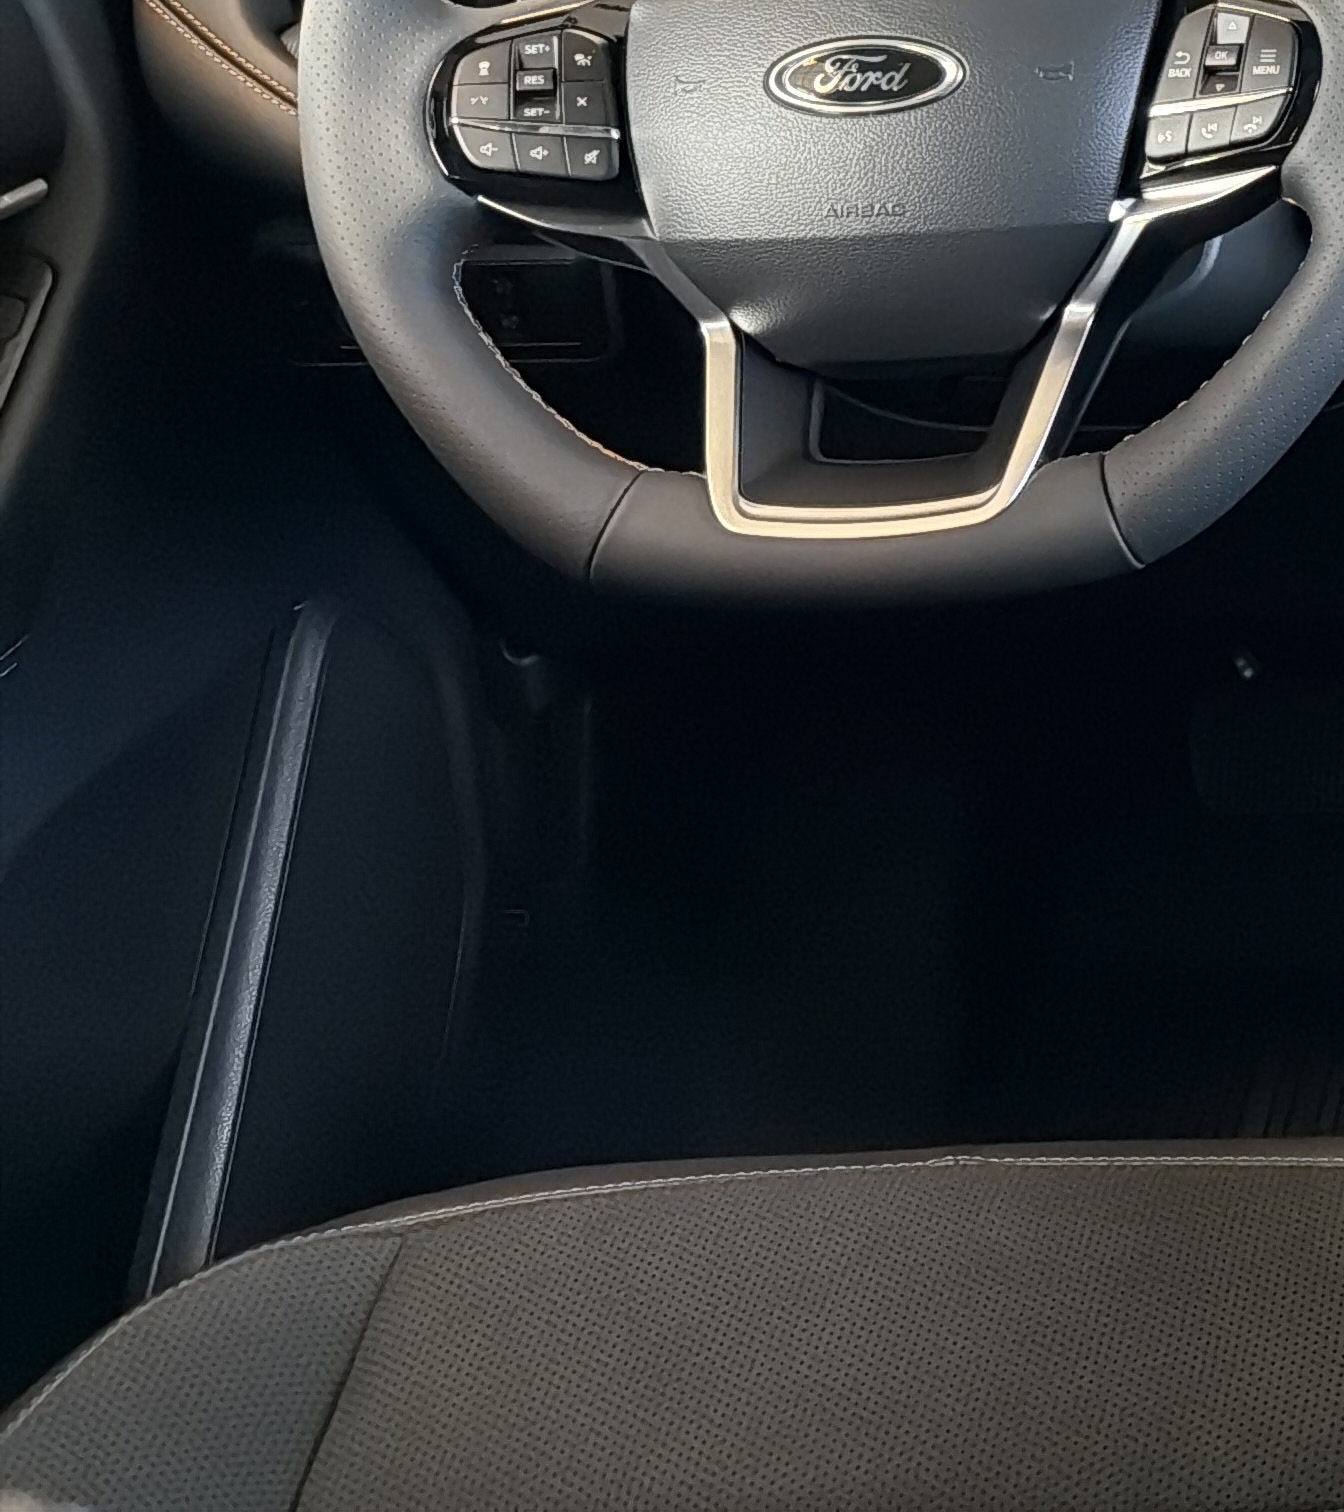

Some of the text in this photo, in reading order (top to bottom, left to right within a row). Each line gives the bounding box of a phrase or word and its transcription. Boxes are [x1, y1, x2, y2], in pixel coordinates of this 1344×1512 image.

[1214, 50, 1228, 60] OK
[813, 54, 913, 94] Ford
[1167, 68, 1192, 79] BACK
[1252, 65, 1281, 75] MENU
[524, 75, 545, 85] RES
[824, 203, 906, 219] AIRBAG
